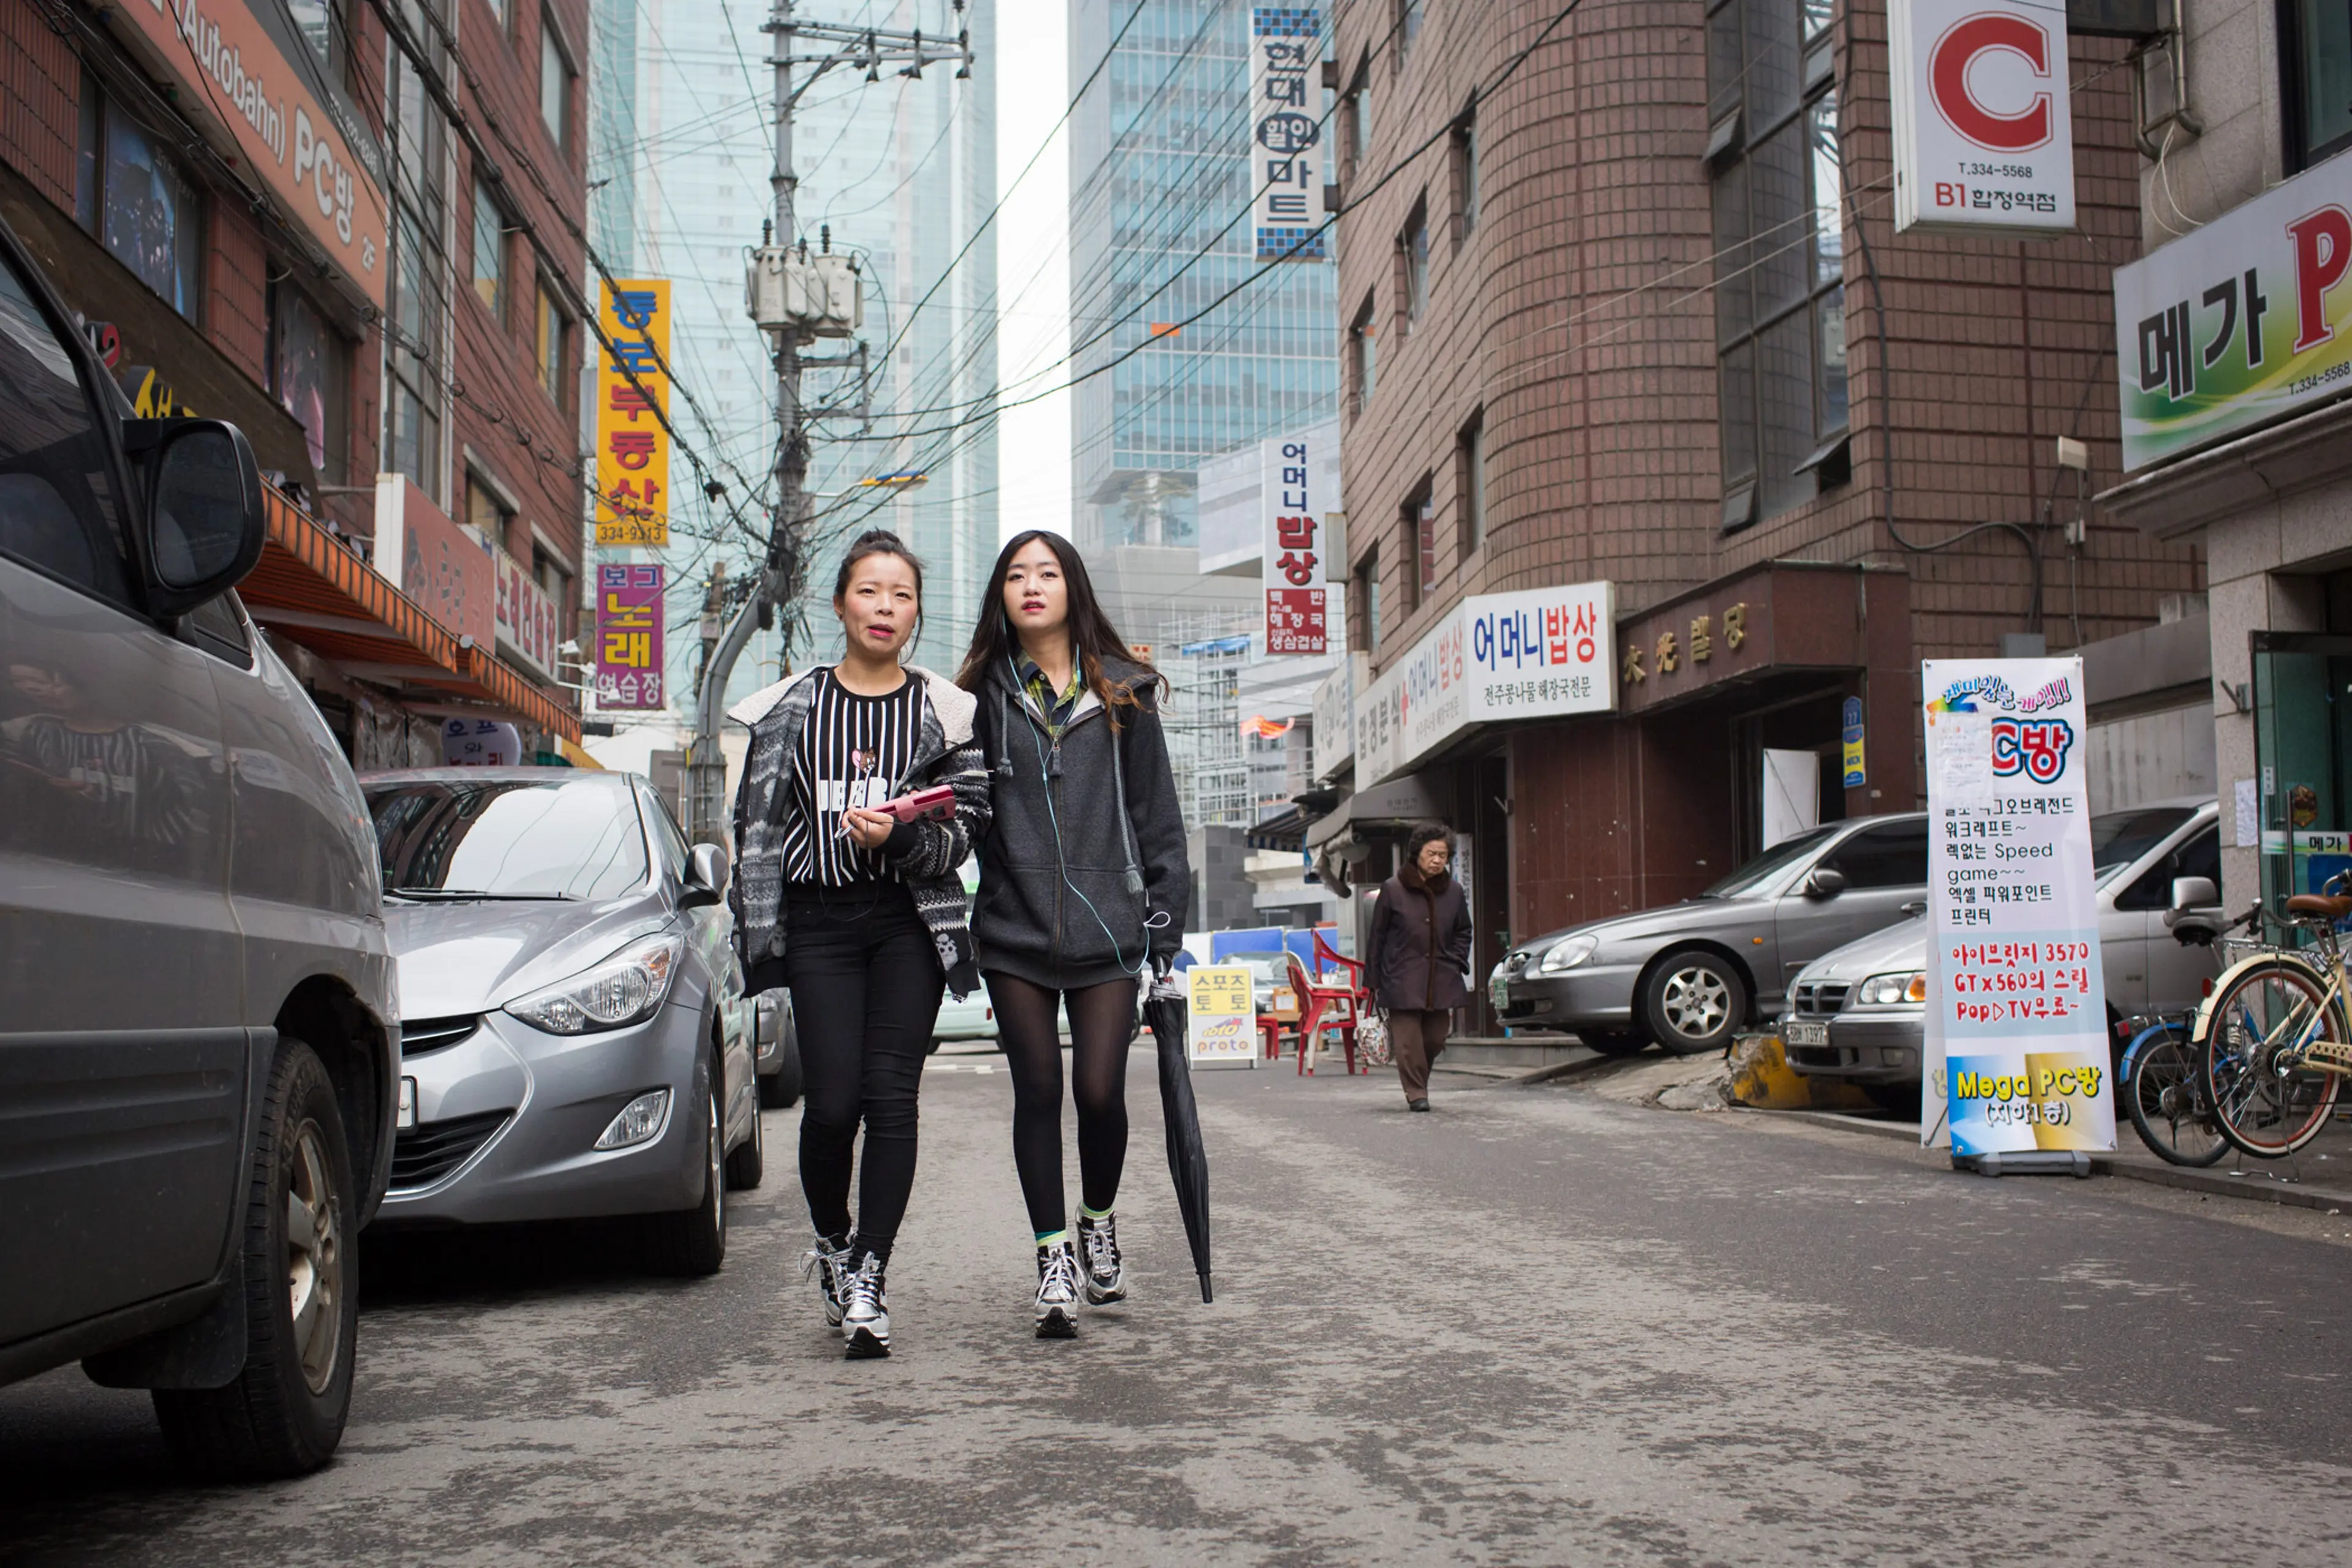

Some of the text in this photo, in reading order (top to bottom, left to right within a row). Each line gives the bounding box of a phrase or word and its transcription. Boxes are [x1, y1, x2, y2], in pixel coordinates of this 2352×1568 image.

[1927, 10, 2053, 154] C
[1264, 42, 1313, 223] 현대 할인 마트
[1959, 162, 2033, 178] T.334-5568
[293, 104, 355, 248] PC방
[361, 235, 376, 273] 2F
[1935, 182, 2056, 213] B1 합정역점
[2138, 203, 2352, 403] 메가 P
[2289, 360, 2351, 396] T.334-5568
[1276, 443, 1318, 586] 어머니밥상
[600, 525, 662, 543] 334-9313
[603, 567, 660, 588] 보그
[496, 551, 557, 677] 노래연습장
[604, 592, 654, 668] 노래
[1270, 635, 1325, 651] 생삼겹살
[1474, 601, 1597, 671] 어머니밥상
[1409, 619, 1463, 713] 어머니밥상
[598, 673, 662, 704] 연습장
[1484, 676, 1592, 707] 전주콩나물 해장국전문
[1942, 675, 2071, 712] 재미있는 게임!!
[1994, 842, 2053, 861] Speed
[2309, 836, 2343, 852] 메가
[1948, 884, 2052, 903] 엑셀 파워포인트
[1951, 908, 1991, 925] 프린터
[1951, 941, 2089, 969] 아이브릿지 3570
[1195, 974, 1246, 991] 스포츠
[2052, 967, 2089, 994] 스릴
[1196, 993, 1246, 1011] 토토
[1197, 1039, 1248, 1055] proto
[1956, 1071, 2033, 1102] Mega
[2040, 1066, 2102, 1098] PC방
